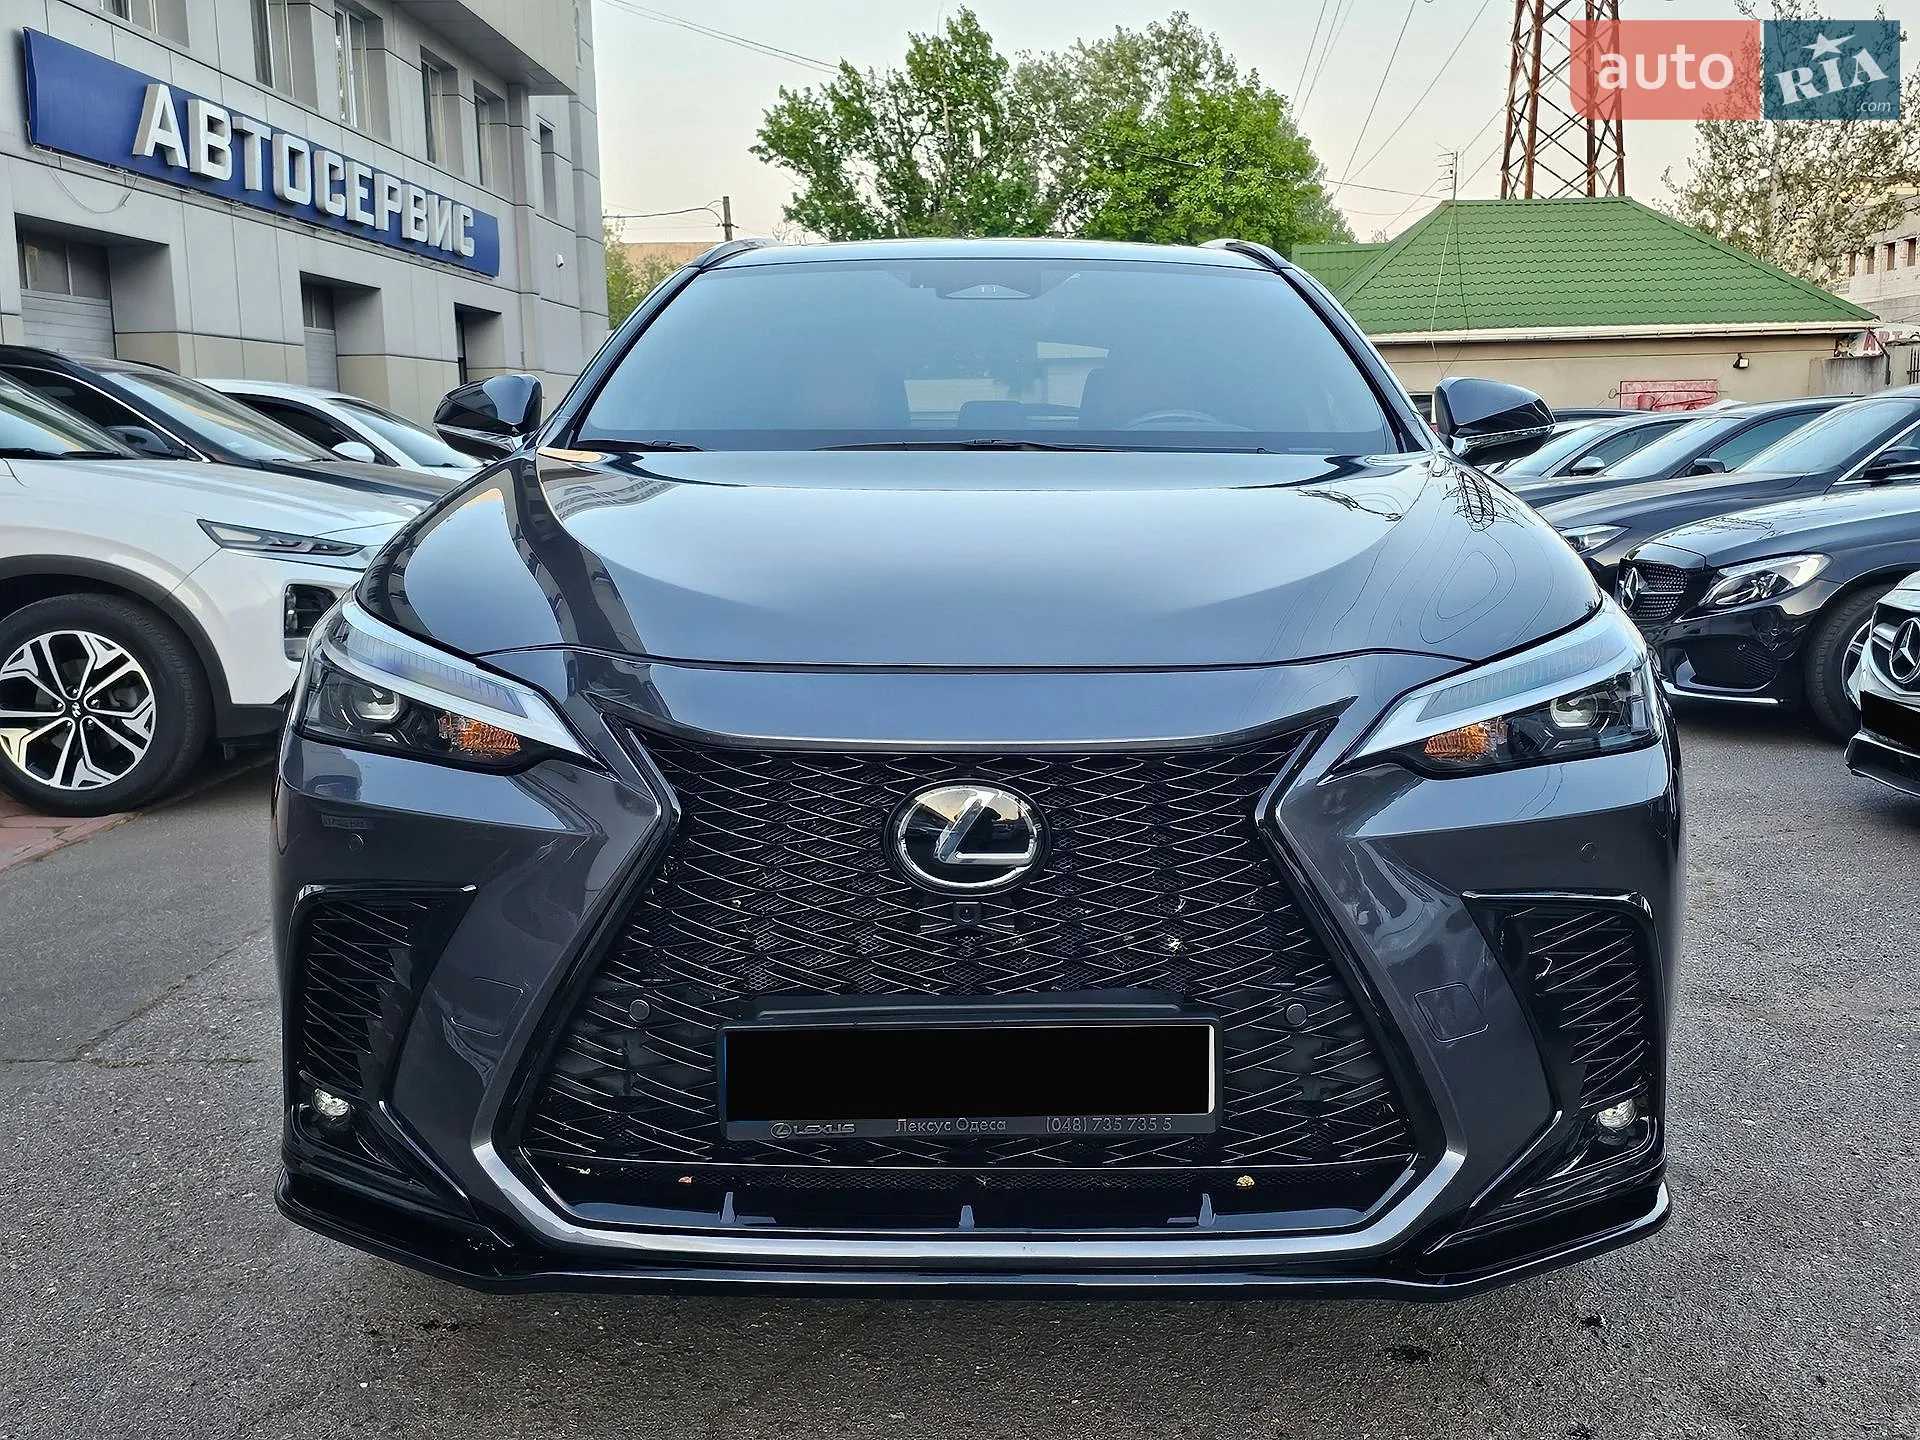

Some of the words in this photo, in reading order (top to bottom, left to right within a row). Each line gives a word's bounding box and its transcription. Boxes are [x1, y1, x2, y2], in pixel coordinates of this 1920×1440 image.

[132, 83, 475, 258] АВТОСЕРВИС
[793, 1122, 856, 1136] LEXUS
[895, 1117, 951, 1135] Лексус
[955, 1116, 1007, 1133] Одеса
[1046, 1115, 1088, 1133] (048)
[1091, 1116, 1122, 1132] 735
[1127, 1116, 1157, 1132] 735
[1161, 1116, 1172, 1132] 5
